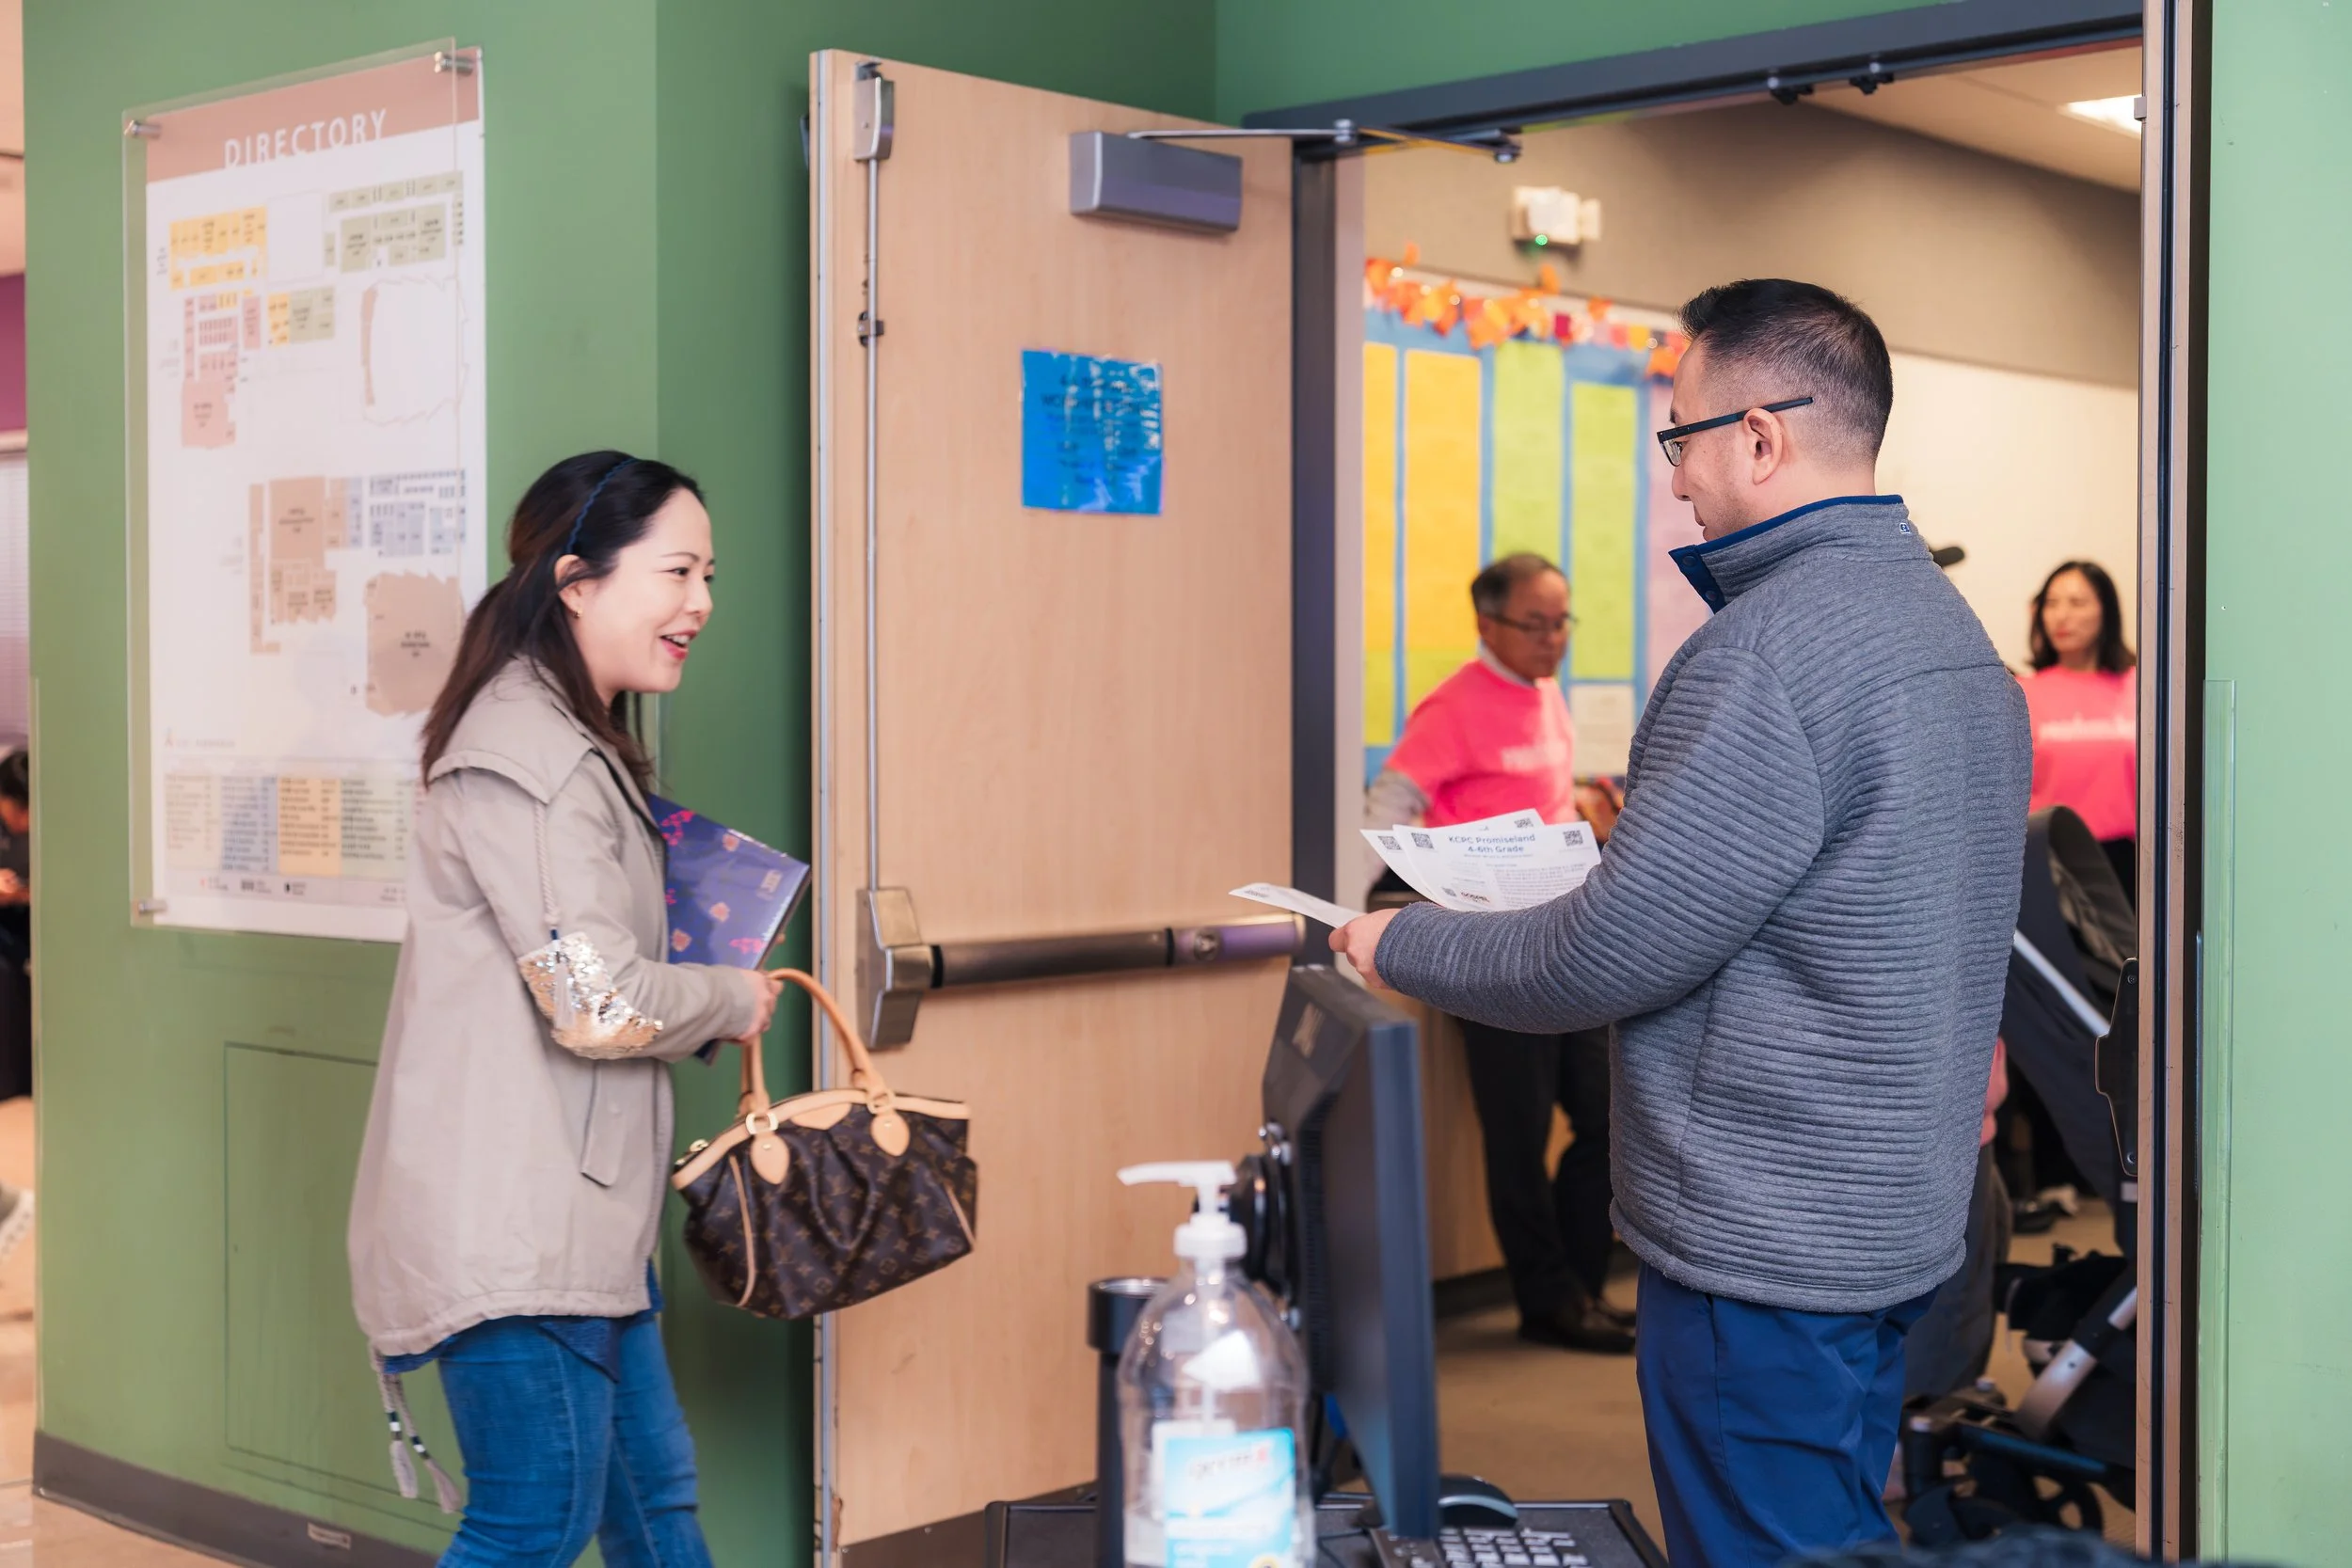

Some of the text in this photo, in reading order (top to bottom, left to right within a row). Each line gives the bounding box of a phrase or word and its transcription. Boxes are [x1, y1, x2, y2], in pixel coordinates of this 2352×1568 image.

[224, 108, 387, 168] DIRECTORY
[1448, 833, 1535, 844] KCPC Promiseland
